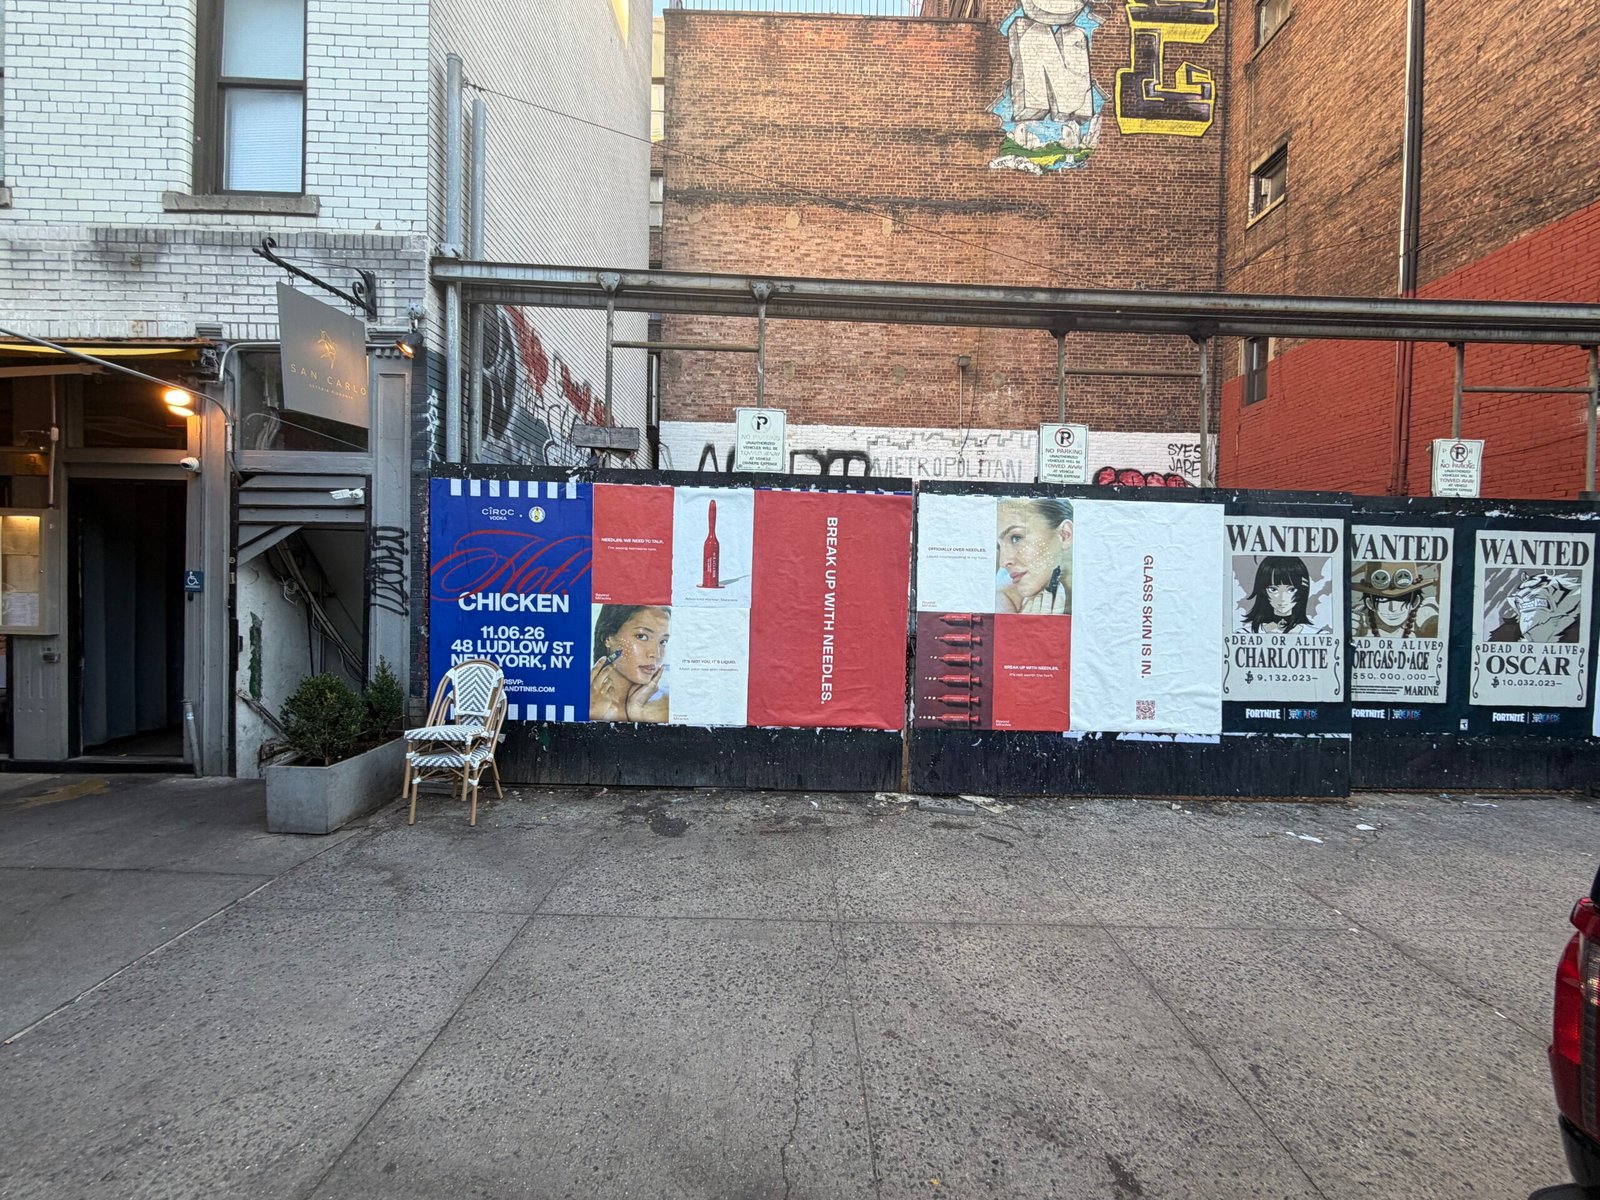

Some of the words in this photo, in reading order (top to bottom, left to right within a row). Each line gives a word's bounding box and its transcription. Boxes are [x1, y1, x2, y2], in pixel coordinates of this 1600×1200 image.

[290, 364, 318, 380] SAN
[327, 376, 367, 396] CARLO
[870, 456, 1021, 482] METROPOLITAN
[826, 517, 838, 566] BREAK
[1225, 524, 1339, 554] WANTED
[1480, 538, 1590, 567] WANTED
[825, 571, 836, 589] UP
[1143, 555, 1154, 602] GLASS
[458, 592, 569, 612] CHICKEN
[824, 593, 836, 630] WITH
[1142, 606, 1153, 639] SKIN
[481, 626, 545, 640] 11.06.26
[1232, 636, 1263, 645] DEAD
[1272, 636, 1286, 646] OR
[1295, 637, 1333, 646] ALIVE
[451, 639, 473, 652] 48
[477, 640, 549, 654] LUDLOW
[552, 641, 574, 654] ST
[1141, 644, 1151, 656] IS
[1379, 640, 1393, 649] OR
[1401, 640, 1438, 650] ALIVE
[1482, 644, 1512, 653] DEAD
[1520, 644, 1534, 654] OR
[1542, 645, 1578, 654] ALIVE
[495, 655, 547, 670] YORK,
[550, 656, 574, 668] NY
[1235, 647, 1328, 669] CHARLOTTE
[1486, 655, 1571, 676] OSCAR
[821, 635, 834, 704] NEEDLES.
[1141, 660, 1151, 678] IN.
[1404, 685, 1439, 696] MARINE
[1246, 708, 1281, 719] FORTNITE
[1351, 708, 1386, 719] FORTNITE
[1492, 712, 1525, 722] FORTNITE
